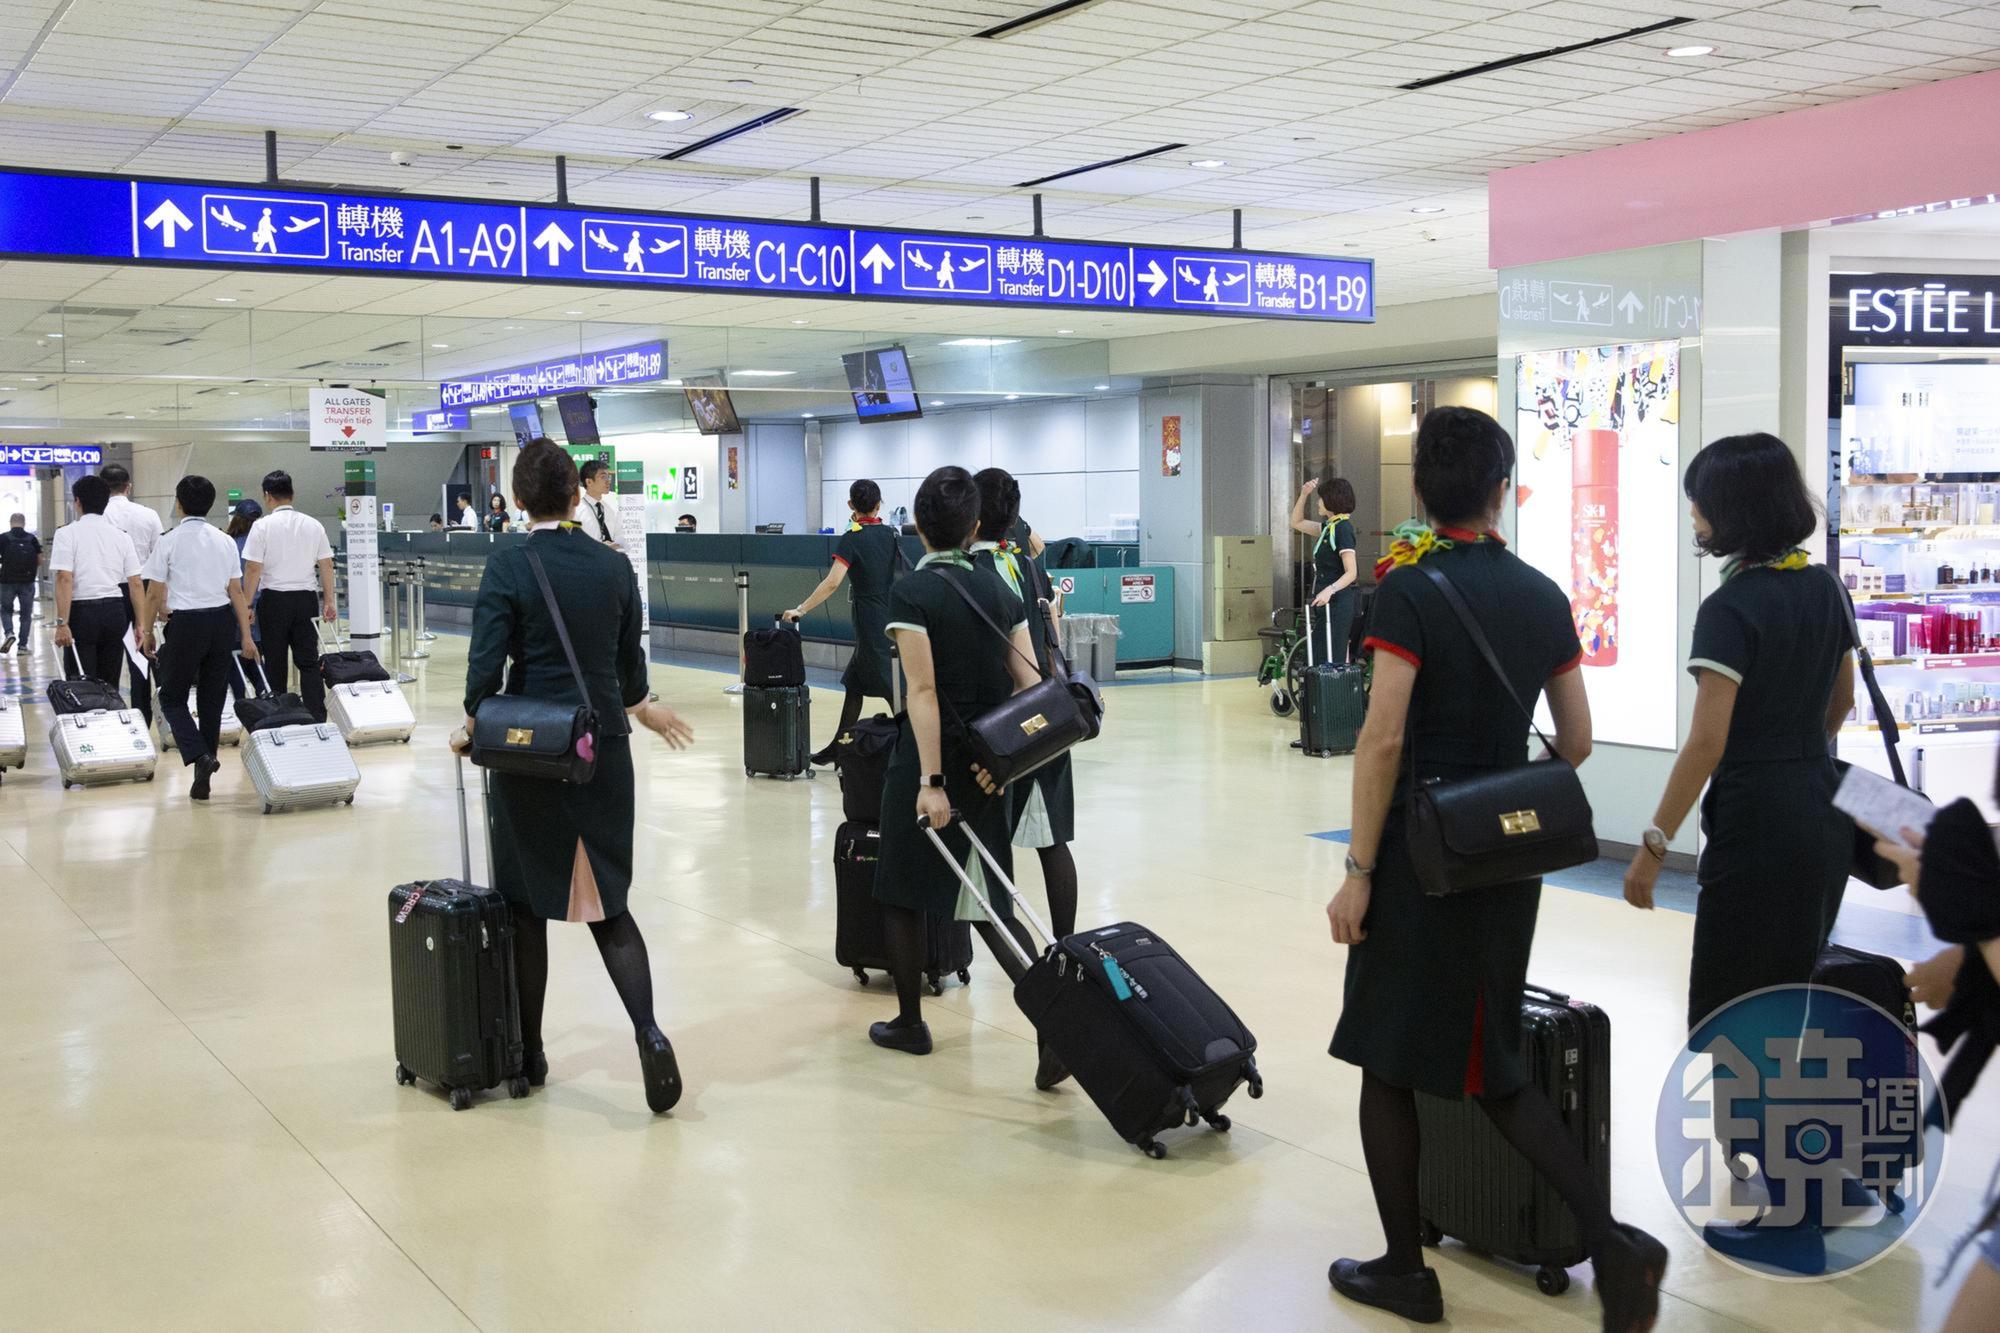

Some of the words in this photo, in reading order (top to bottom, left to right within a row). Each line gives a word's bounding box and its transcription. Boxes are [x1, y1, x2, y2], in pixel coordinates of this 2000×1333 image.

[336, 203, 404, 239] 轉機
[338, 241, 404, 263] Transfer
[410, 219, 516, 268] A1-A9
[694, 227, 750, 260] 轉機
[695, 261, 750, 282] Transfer
[755, 240, 846, 287] C1-C10
[996, 247, 1045, 277] 轉機
[1254, 262, 1297, 290] 轉機
[998, 278, 1044, 297] Transfer
[1048, 258, 1126, 301] D1-D10
[1299, 273, 1367, 312] B1-B9
[1256, 291, 1296, 309] Transfer
[325, 398, 340, 406] ALL
[343, 397, 371, 406] GATES
[326, 407, 371, 415] TRANSFER
[71, 451, 100, 463] C1-C10
